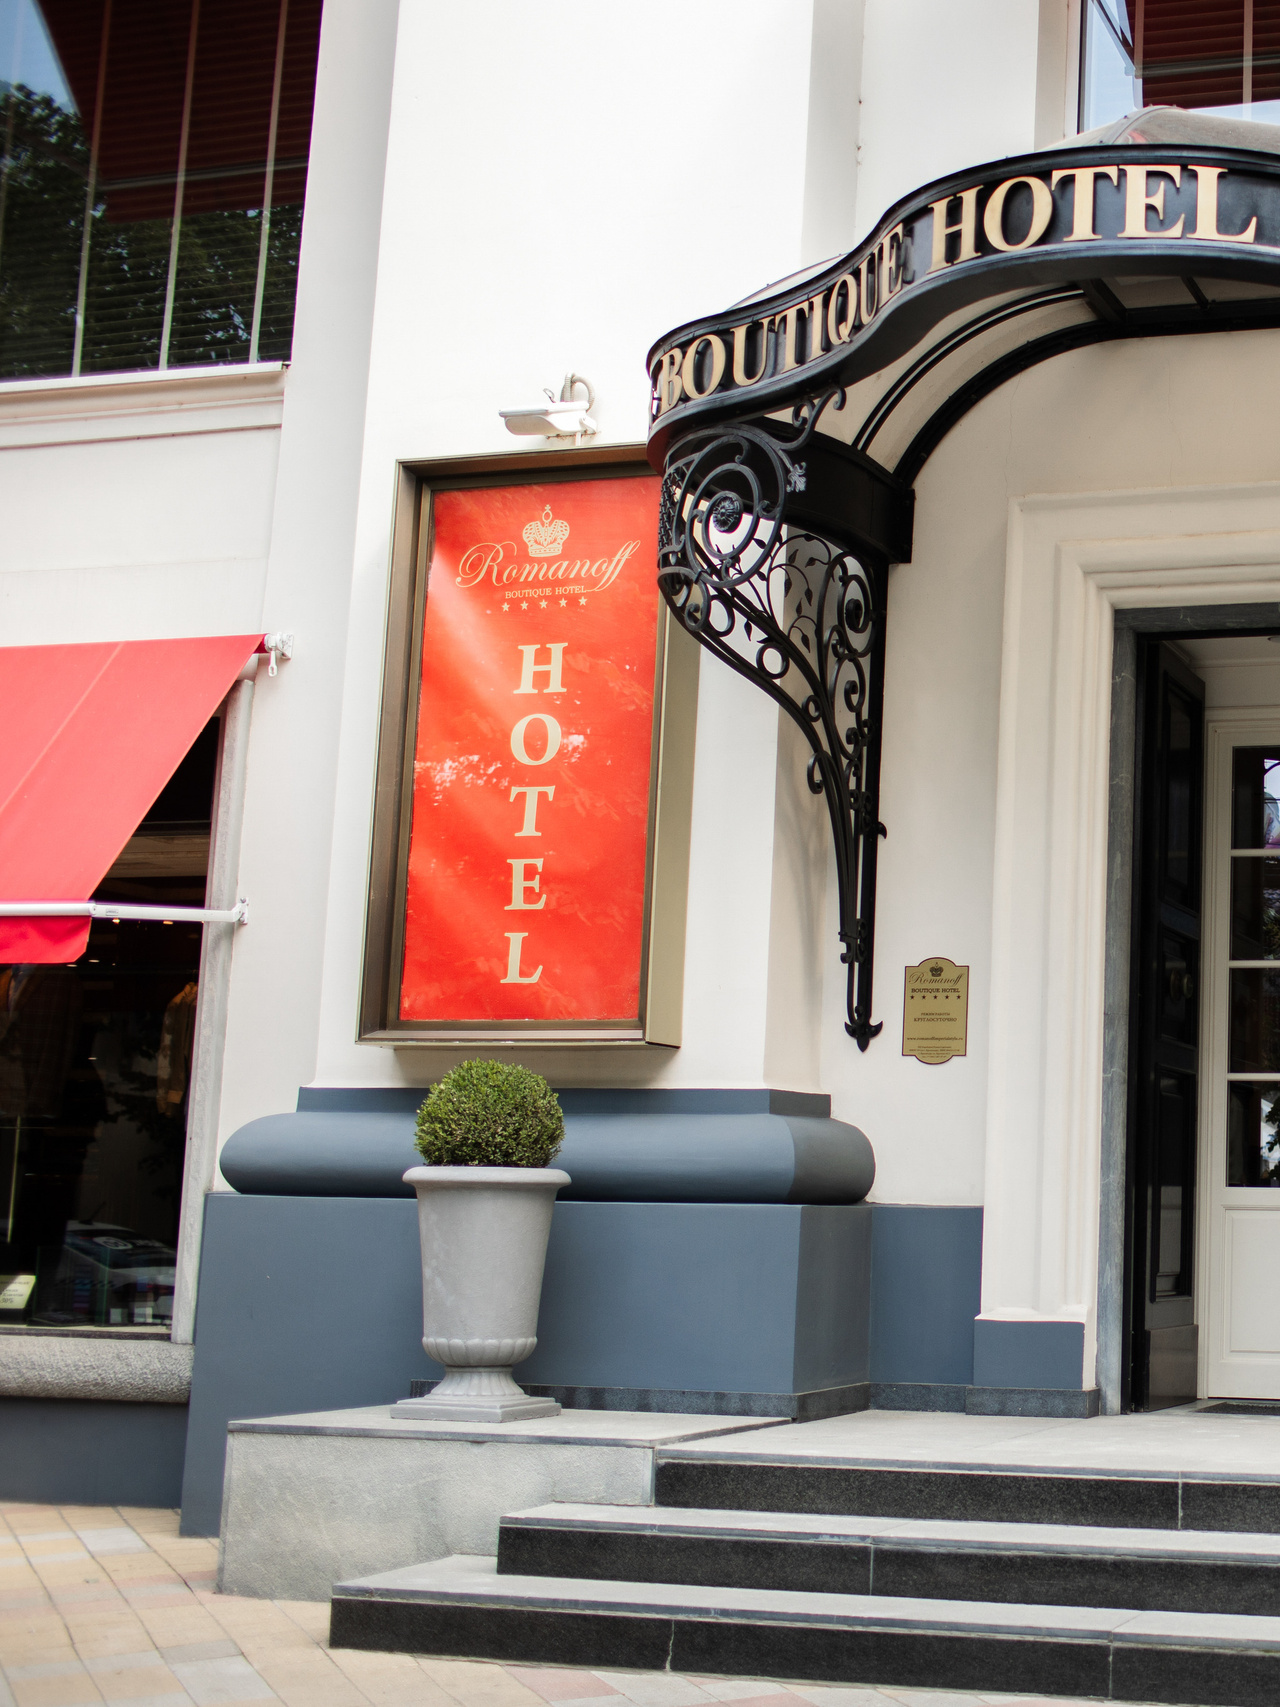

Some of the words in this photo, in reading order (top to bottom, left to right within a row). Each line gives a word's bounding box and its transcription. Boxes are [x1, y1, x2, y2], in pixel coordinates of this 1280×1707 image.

[658, 222, 904, 417] BOUTIQUE
[927, 164, 1257, 274] HOTEL
[455, 540, 641, 592] Romanoff
[505, 586, 552, 599] BOUTIQUE
[555, 585, 587, 595] HOTEL
[500, 642, 569, 984] HOTEL
[908, 972, 964, 986] Romanoff
